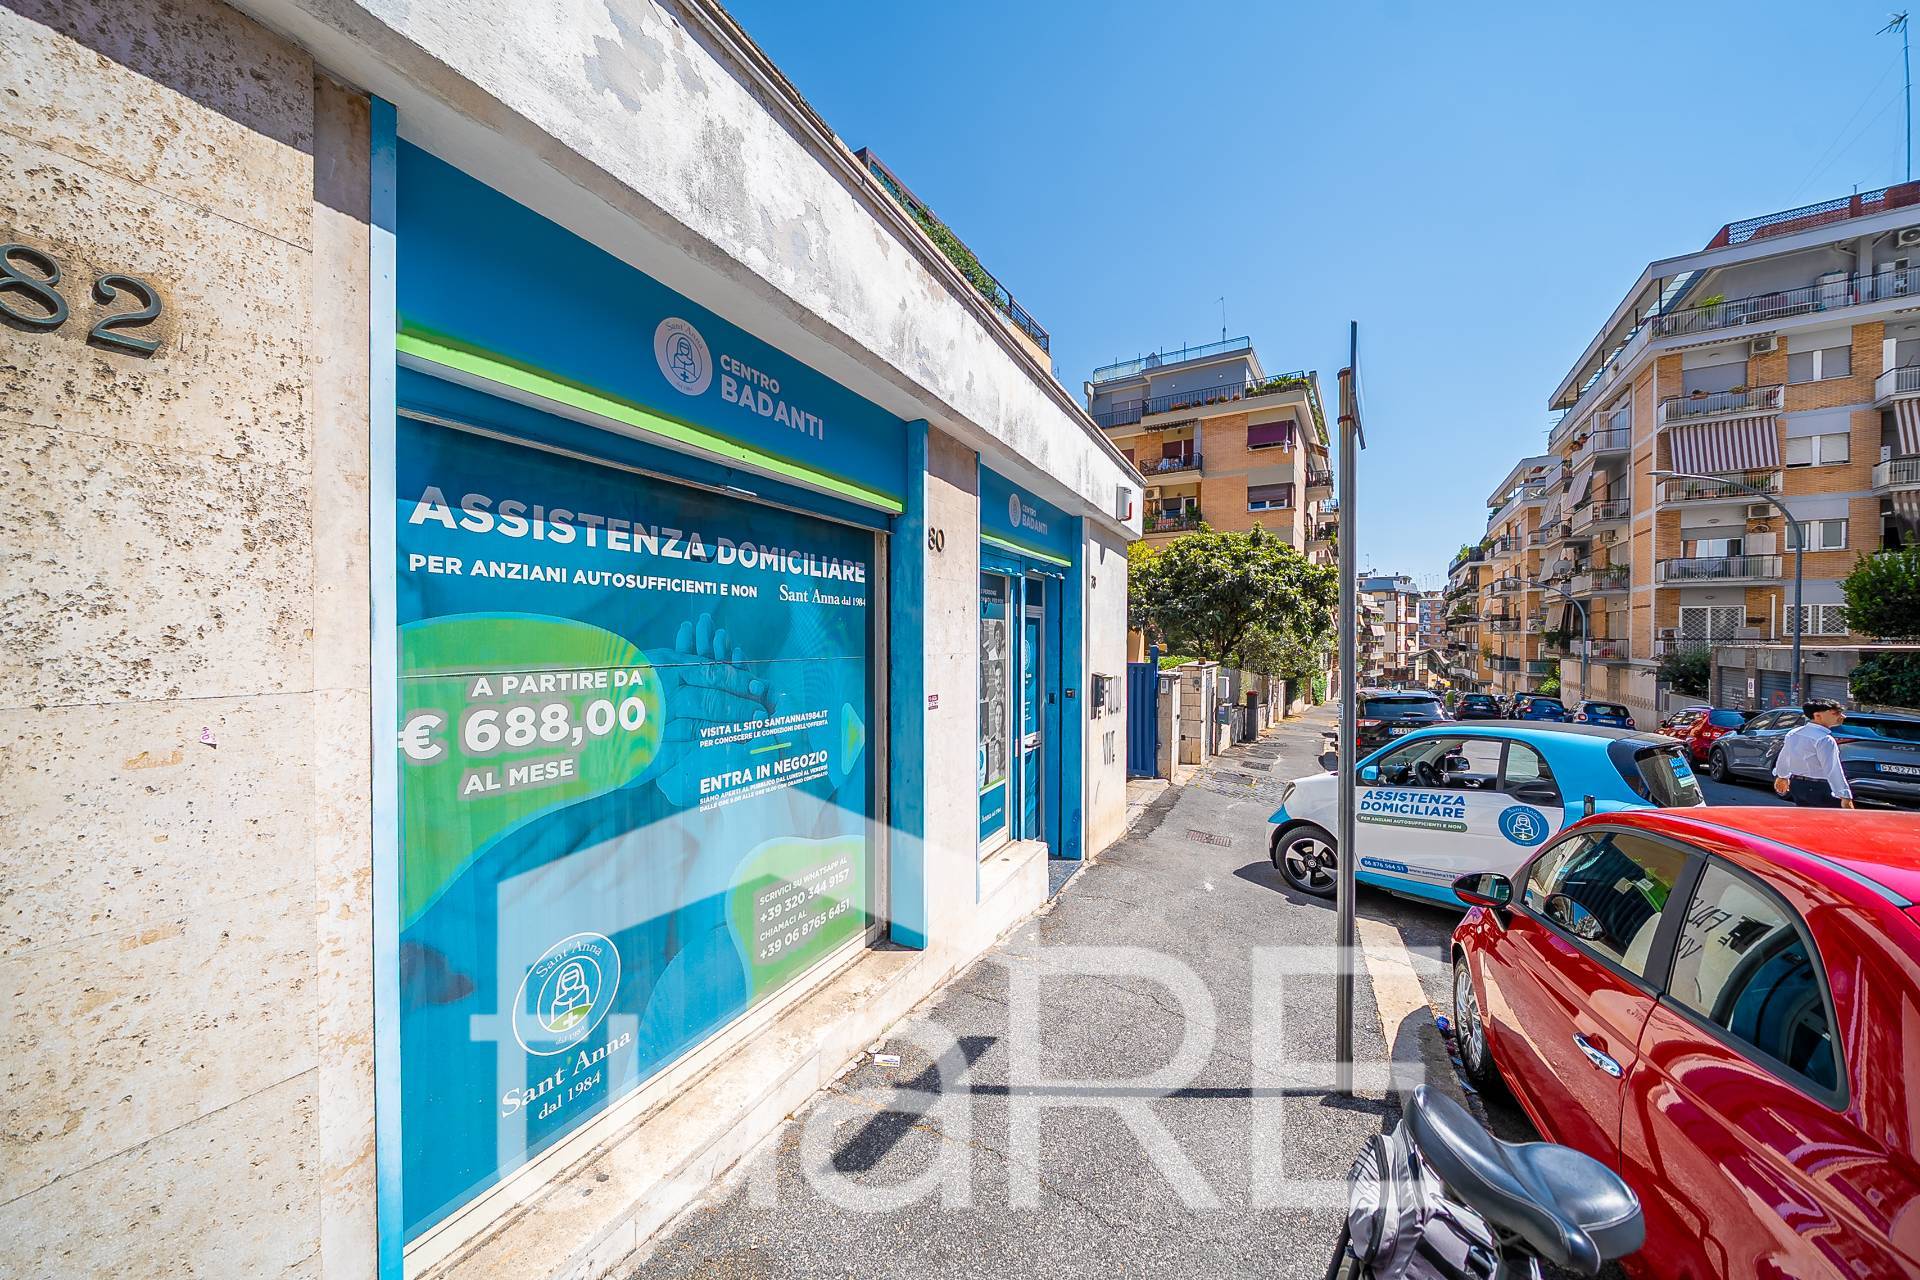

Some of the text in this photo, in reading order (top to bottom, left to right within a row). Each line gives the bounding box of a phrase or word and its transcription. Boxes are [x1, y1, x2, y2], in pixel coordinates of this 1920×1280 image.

[0, 243, 163, 359] 82
[720, 354, 780, 394] CENTRO
[721, 373, 824, 441] BADANTI
[1022, 504, 1037, 517] CENTRO
[1022, 513, 1048, 535] BADANTI
[408, 485, 866, 583] ASSISTENZA DOMICILIARE
[928, 526, 945, 552] 80
[409, 553, 758, 598] PER ANZIANI AUTOSUFFICIENTI E NON
[842, 597, 851, 606] dal
[471, 670, 643, 697] A PARTIRE DA
[397, 696, 647, 760] € 688,00
[700, 709, 828, 738] VISITA IL SITO SANTANNA1984.IT
[700, 740, 713, 748] PER
[714, 732, 753, 746] CONOSCERE
[762, 724, 793, 737] CONDIZIONI
[464, 759, 574, 795] AL MESE
[700, 750, 828, 795] ENTRA IN NEGOZIO
[700, 793, 719, 805] SIAMO
[721, 788, 741, 800] APERTI
[776, 776, 786, 784] DAL
[700, 801, 718, 813] DALLE
[1363, 790, 1466, 806] ASSISTENZA
[1361, 801, 1465, 819] DOMICILIARE
[1393, 819, 1442, 828] AUTOSUFFICIENTI
[759, 856, 848, 906] SCRIVICI SU WHATSAPP AL
[760, 868, 850, 923] +39 320 344 9157
[760, 910, 807, 941] CHIAMACI AL
[760, 898, 850, 959] +39 06 8765 6451
[535, 940, 603, 978] Sant'Anna
[538, 1071, 602, 1120] dal 1984
